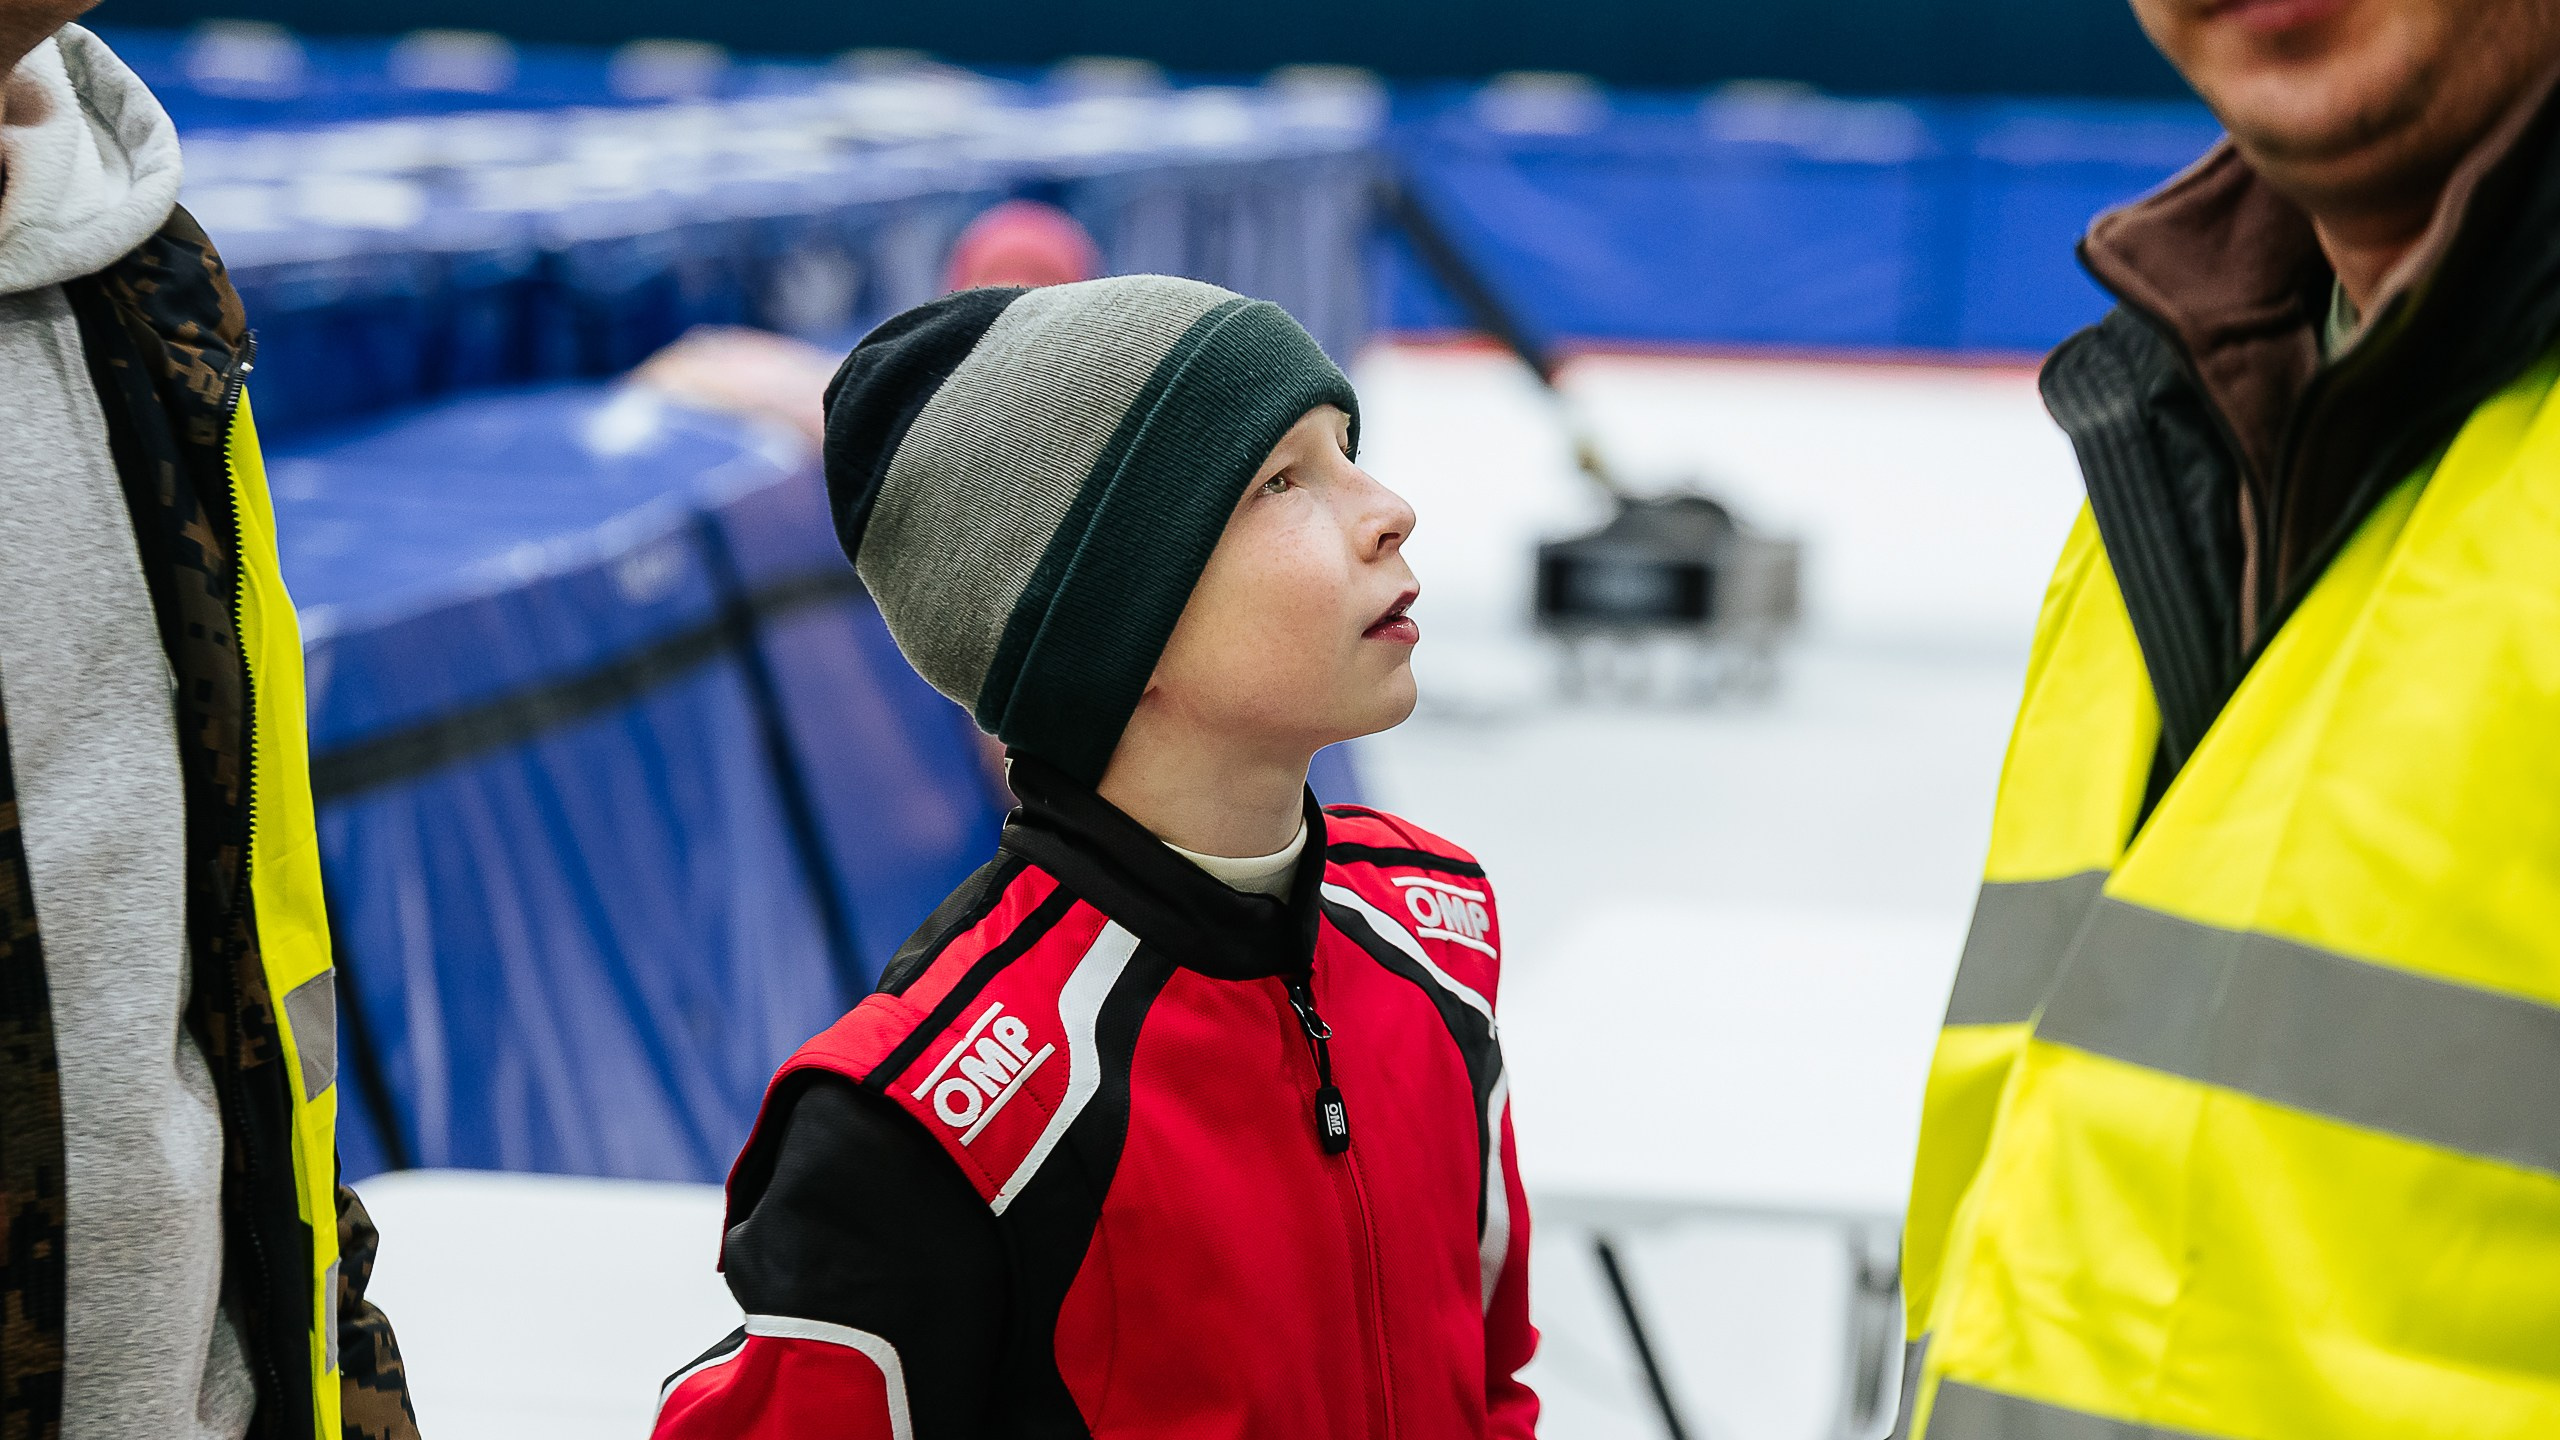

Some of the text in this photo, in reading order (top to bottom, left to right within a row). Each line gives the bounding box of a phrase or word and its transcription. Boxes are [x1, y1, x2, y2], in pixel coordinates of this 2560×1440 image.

[1404, 886, 1490, 941] OMP
[933, 1015, 1032, 1128] OMP
[1328, 1103, 1342, 1135] OMP
